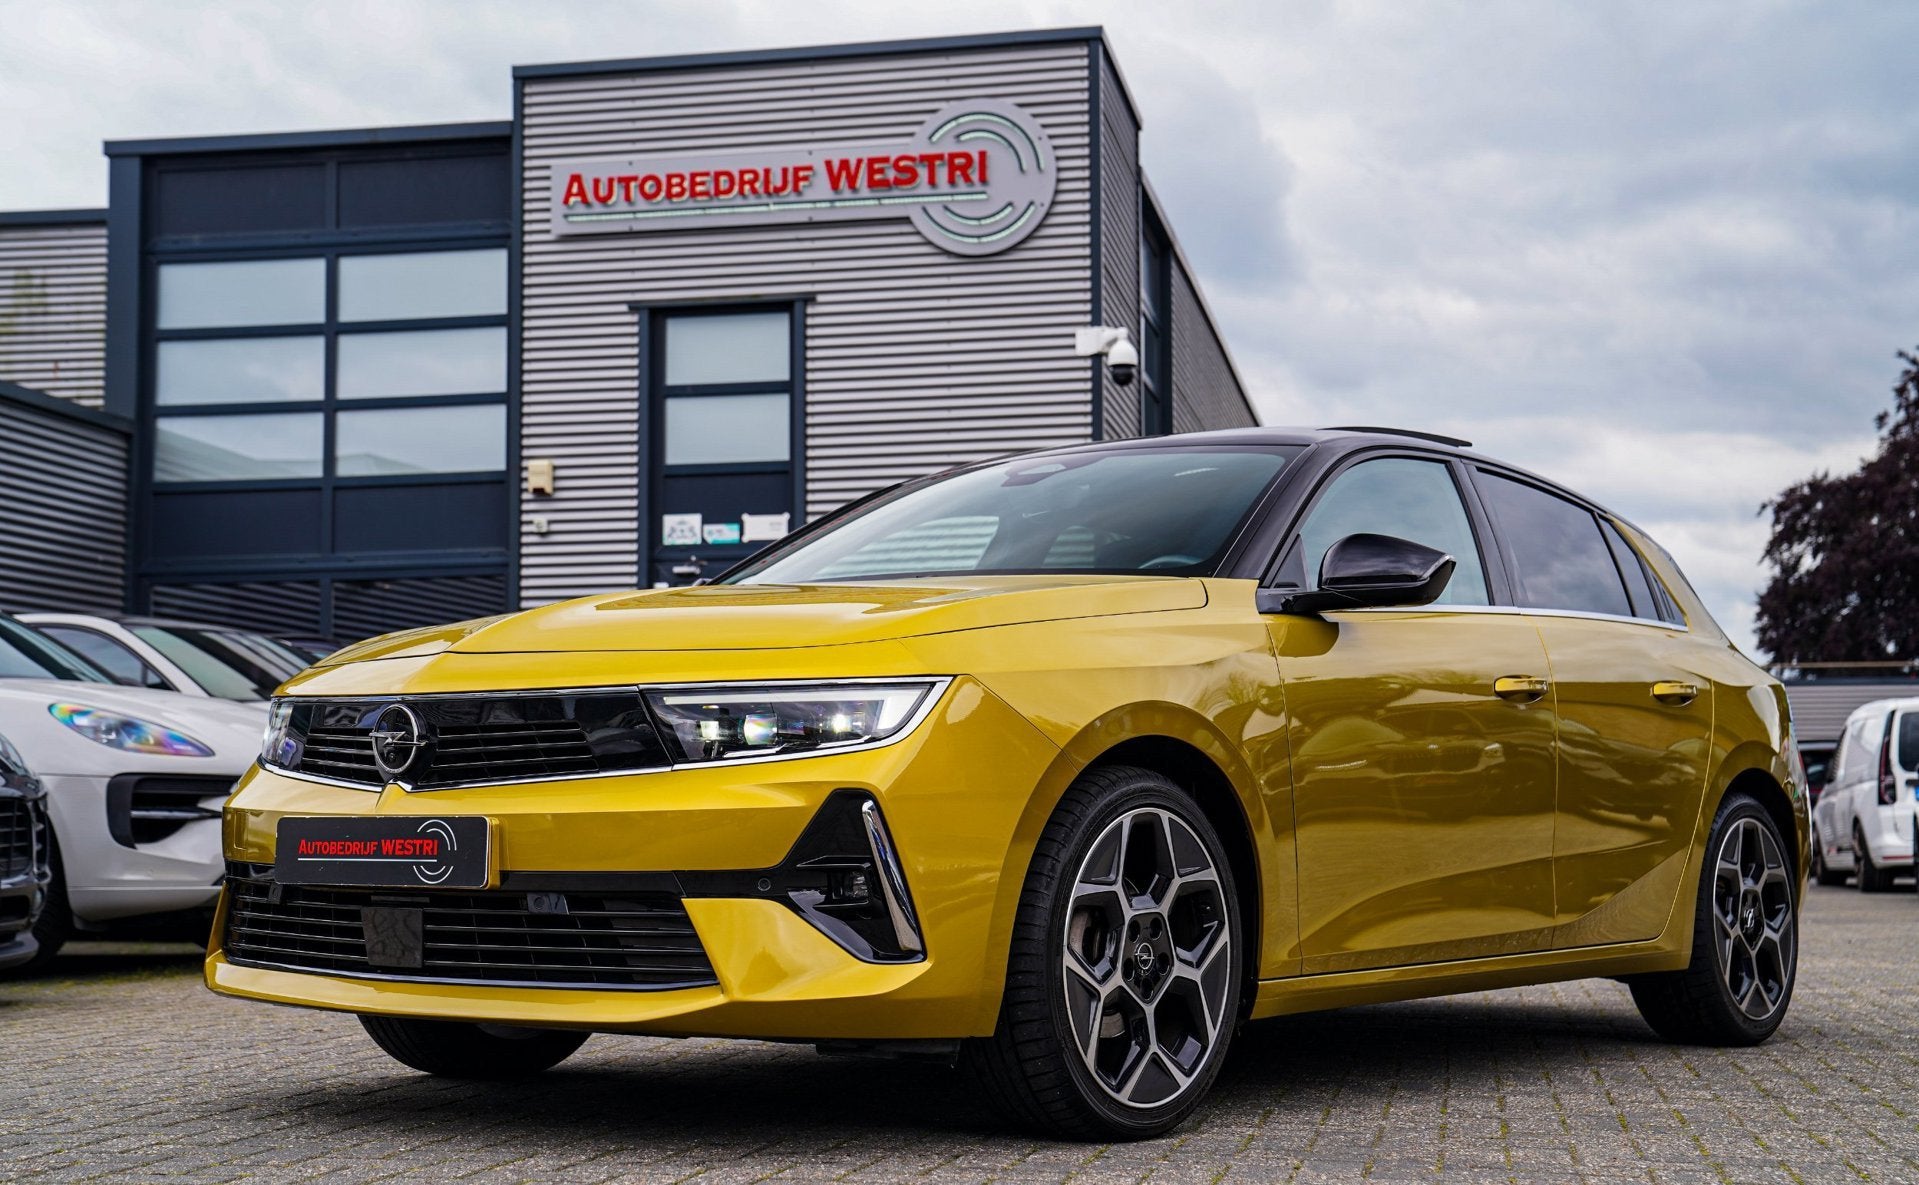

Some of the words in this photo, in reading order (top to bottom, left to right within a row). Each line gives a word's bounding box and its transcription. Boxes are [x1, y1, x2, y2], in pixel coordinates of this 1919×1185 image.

[563, 165, 813, 205] AUTOBEDRIJF
[824, 150, 988, 190] WESTRI
[298, 839, 377, 855] AUTOBEDRIJF
[381, 839, 438, 855] WESTRI
